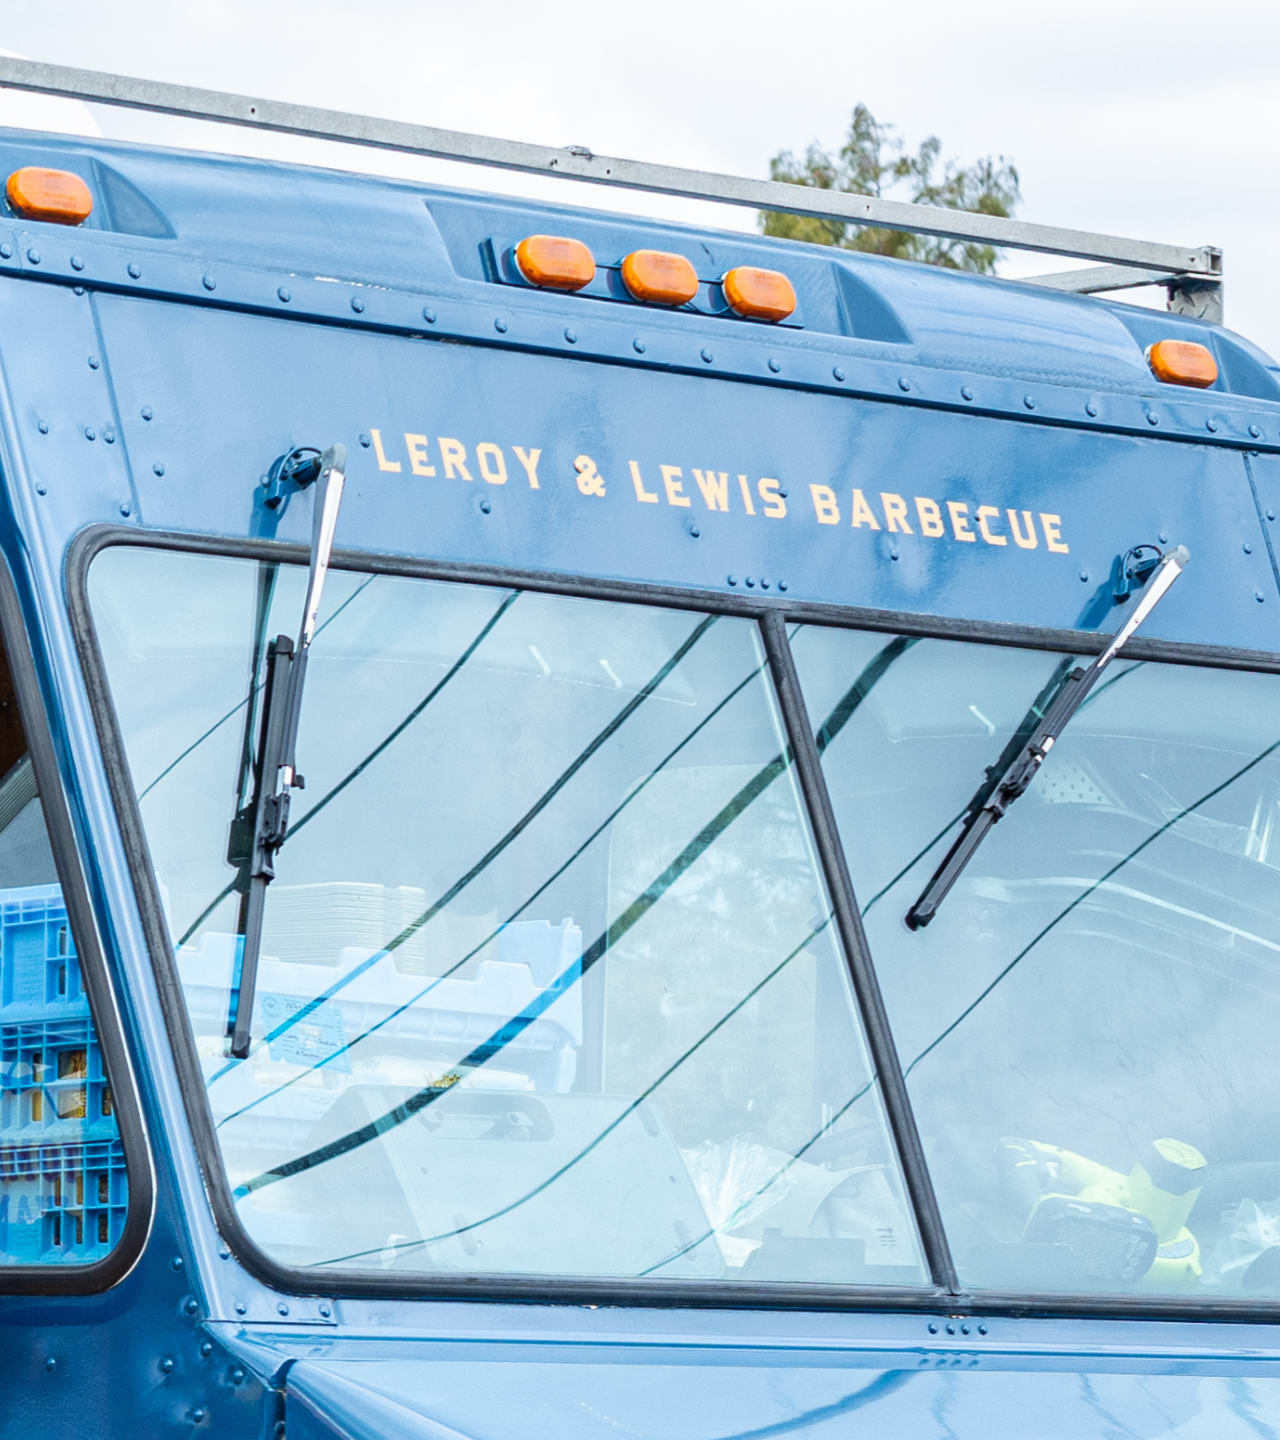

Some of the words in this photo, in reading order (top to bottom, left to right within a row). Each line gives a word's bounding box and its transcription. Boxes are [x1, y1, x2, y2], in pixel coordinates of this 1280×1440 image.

[370, 428, 543, 490] LEROY
[573, 454, 607, 499] &
[629, 460, 789, 520] LEWIS
[810, 483, 1070, 554] BARBECUE
